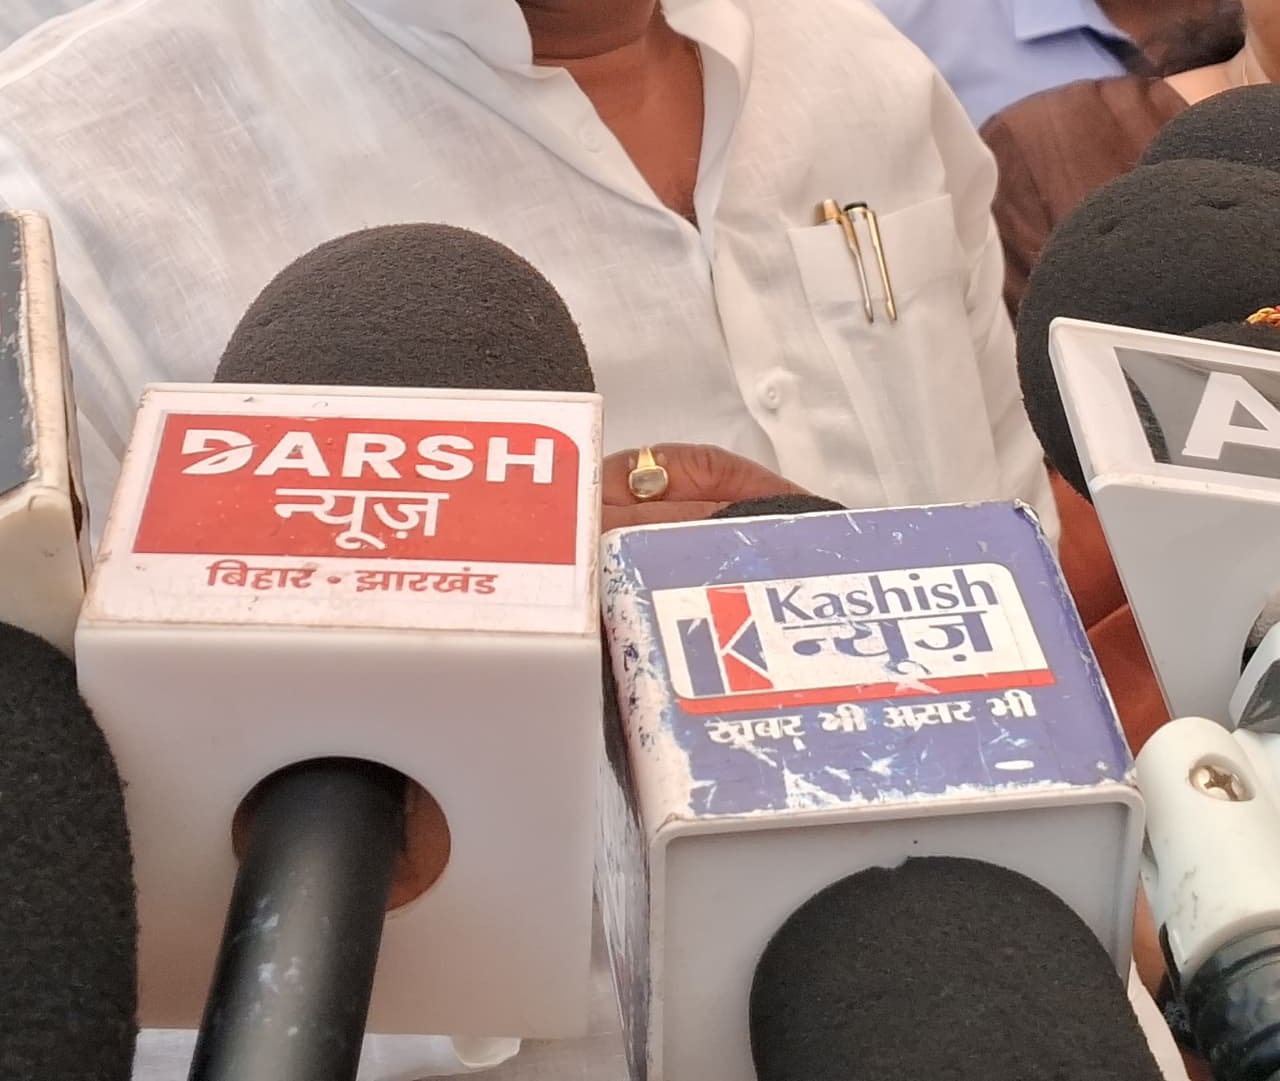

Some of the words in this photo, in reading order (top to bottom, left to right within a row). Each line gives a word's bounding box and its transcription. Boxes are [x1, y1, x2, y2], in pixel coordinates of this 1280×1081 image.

[180, 428, 554, 484] DARSH
[273, 488, 450, 550] न्यूज़
[206, 559, 317, 589] बिहार
[355, 566, 499, 595] झारखंड
[765, 568, 1000, 623] Kashish
[818, 702, 868, 734] भी
[883, 700, 976, 731] असर
[985, 689, 1038, 718] भी
